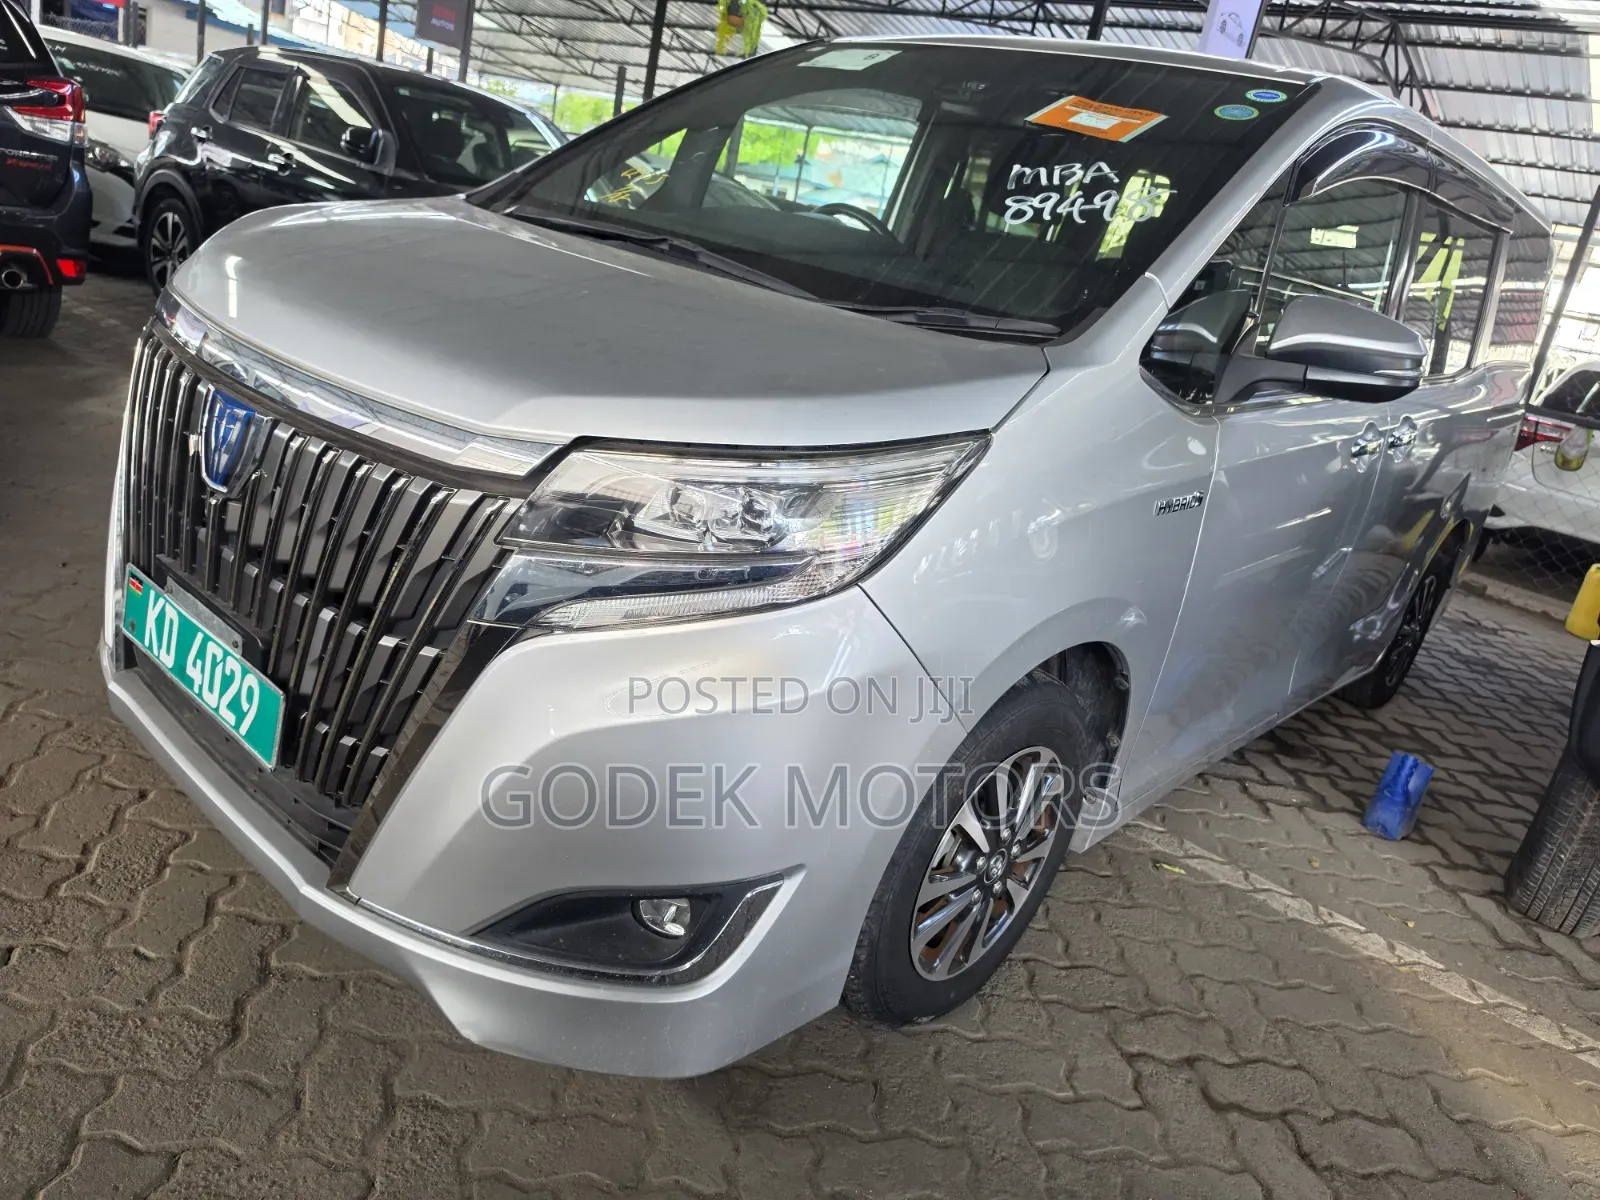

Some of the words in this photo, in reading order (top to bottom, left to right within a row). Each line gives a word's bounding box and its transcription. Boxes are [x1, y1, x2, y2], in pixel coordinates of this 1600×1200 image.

[1007, 161, 1120, 190] MBA
[1003, 186, 1178, 225] 89498
[1153, 491, 1204, 517] HYBRID
[144, 589, 179, 669] KD
[185, 631, 260, 737] 4029
